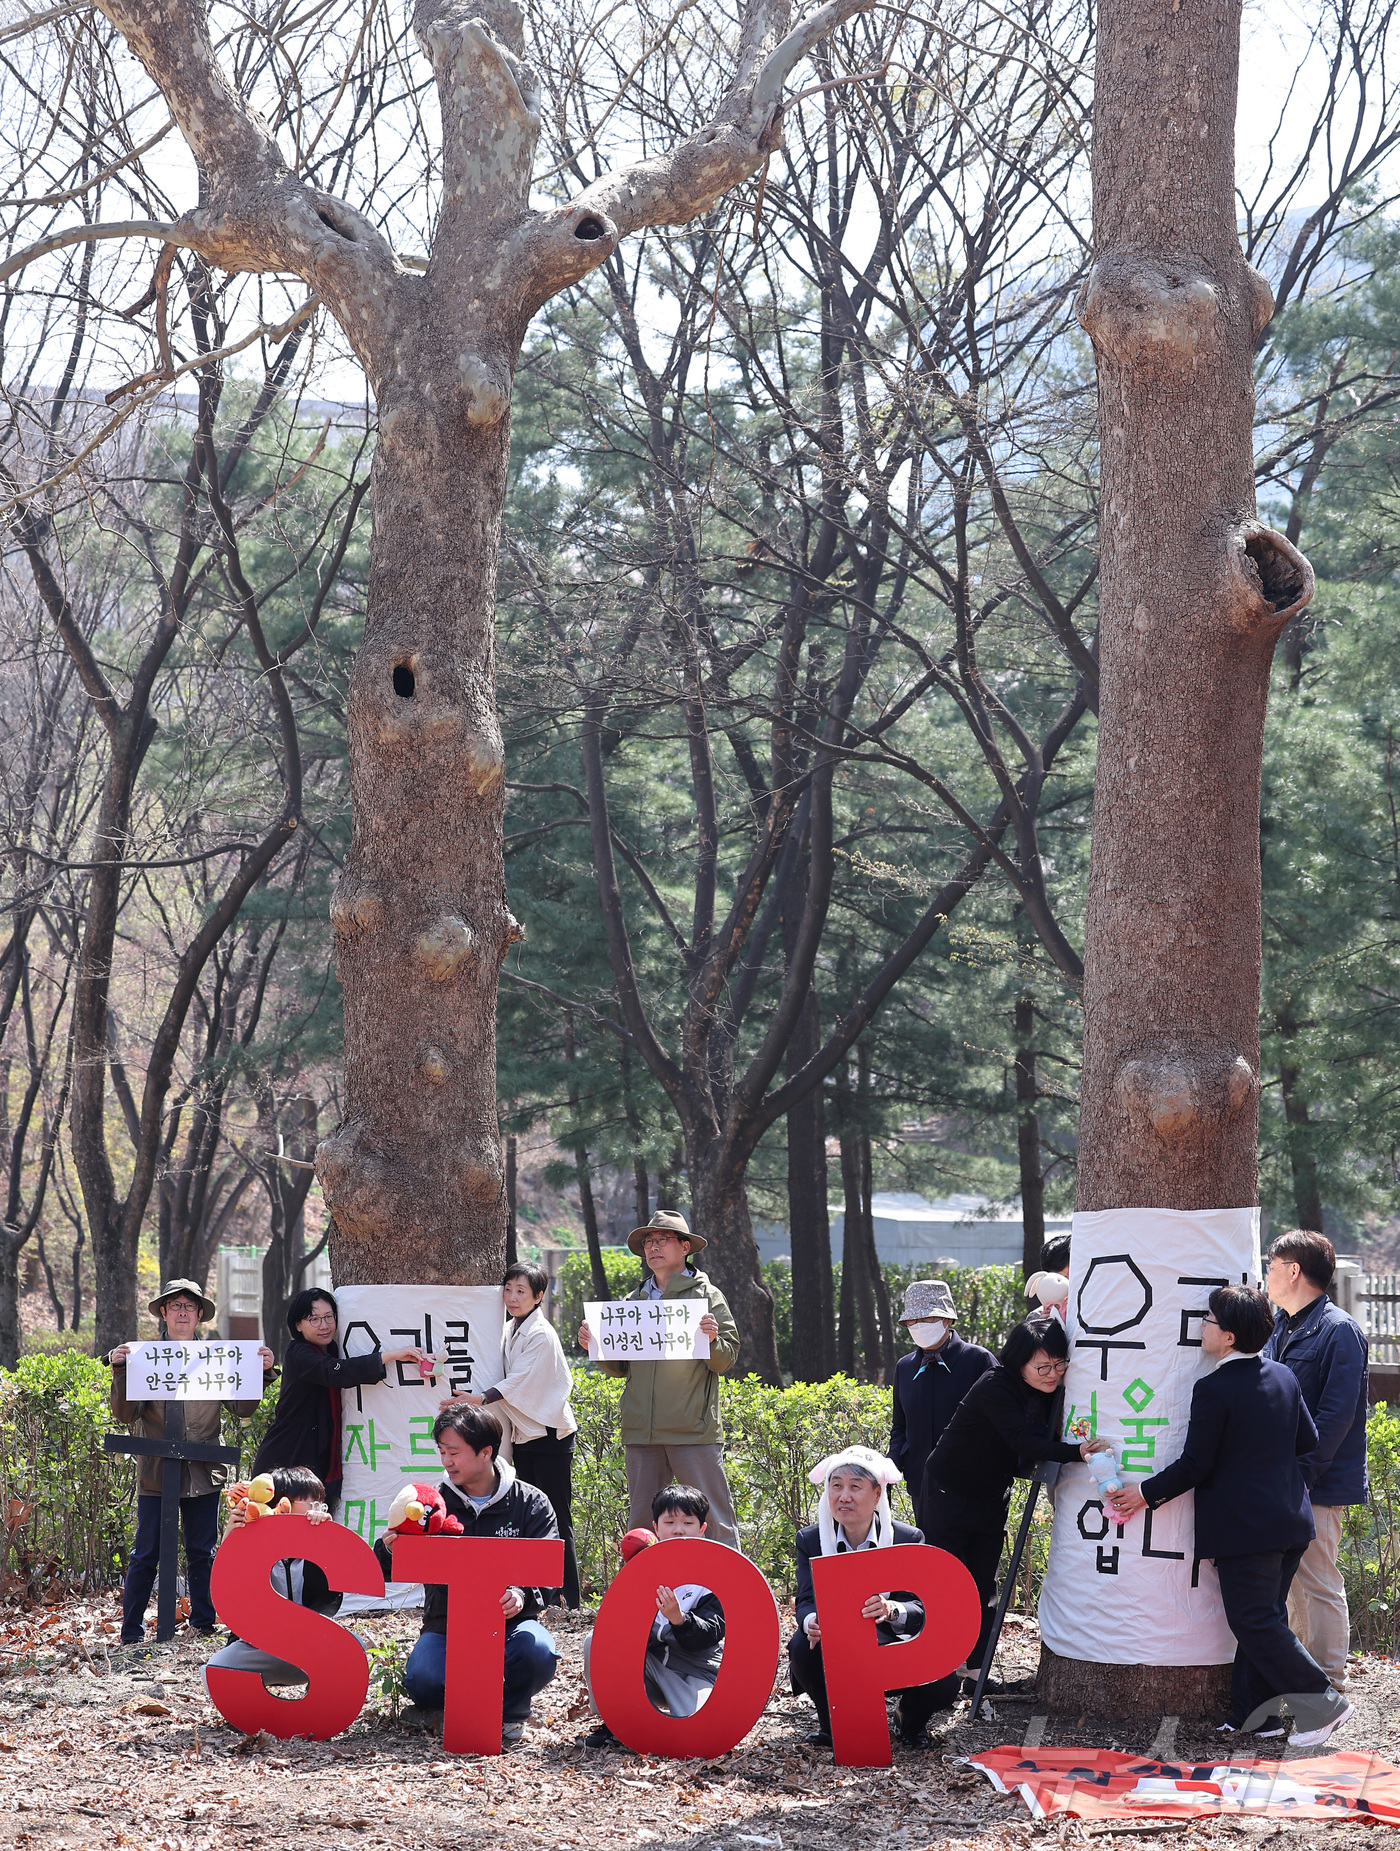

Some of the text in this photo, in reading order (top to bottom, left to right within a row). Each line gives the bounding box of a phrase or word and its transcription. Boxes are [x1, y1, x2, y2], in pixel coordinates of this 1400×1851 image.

[601, 1304, 690, 1326] 나무야 나무야
[603, 1331, 691, 1352] 이성진 나무야
[145, 1346, 242, 1366] 나무야 나무야
[146, 1372, 242, 1393] 안은주 나무야
[345, 1416, 446, 1472] 자르
[207, 1514, 980, 1767] STOP
